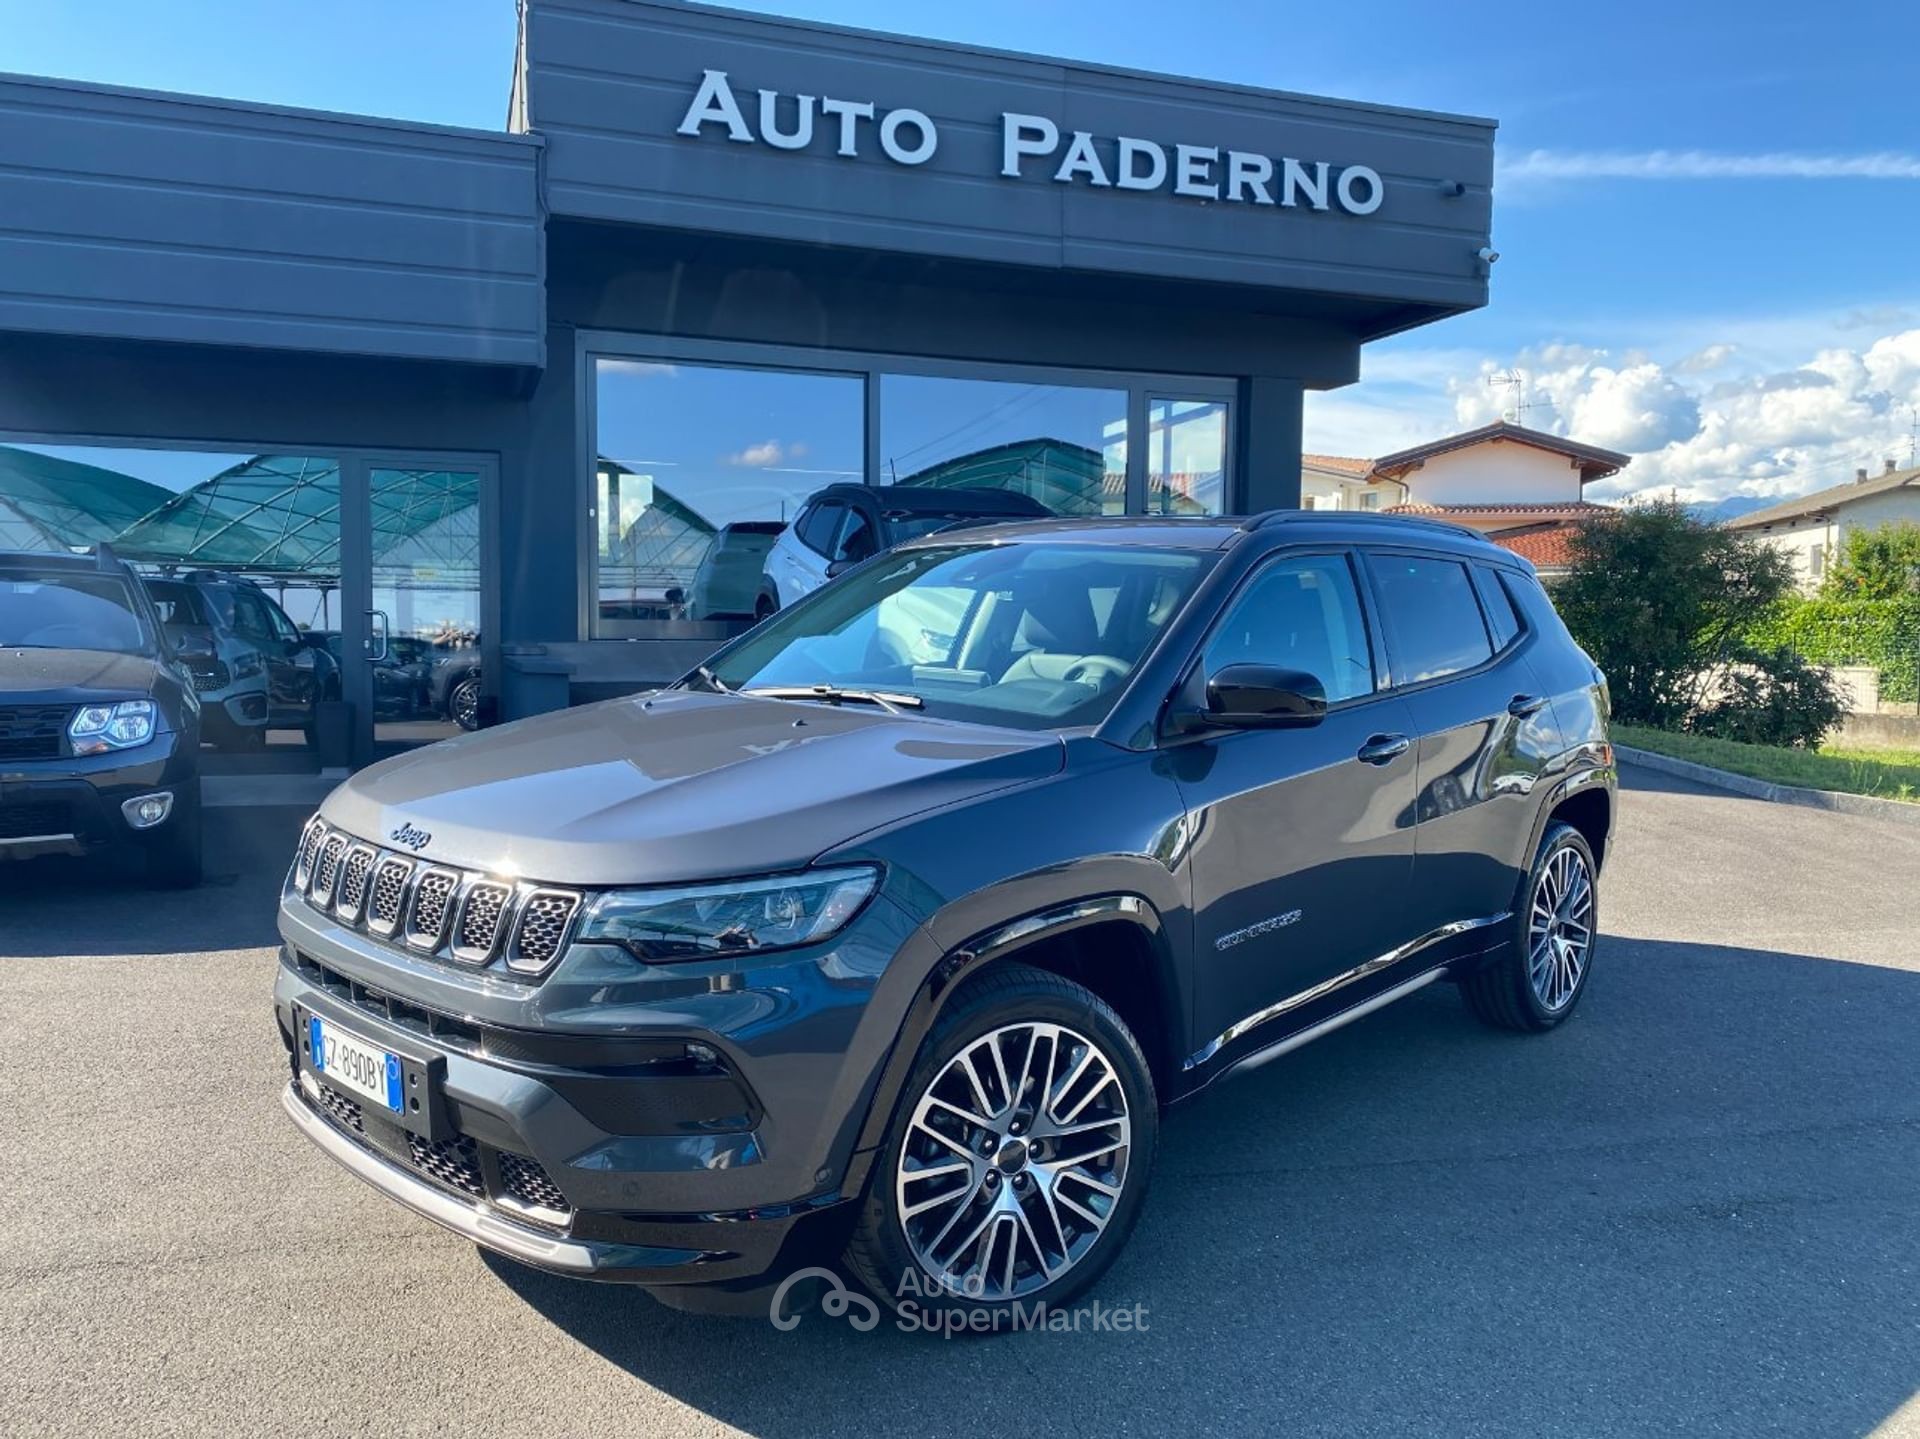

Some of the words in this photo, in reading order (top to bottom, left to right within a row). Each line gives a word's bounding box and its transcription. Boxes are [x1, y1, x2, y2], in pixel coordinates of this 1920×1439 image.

[677, 69, 938, 165] AUTO
[1001, 112, 1384, 216] PADERNO
[391, 822, 432, 851] Jeep
